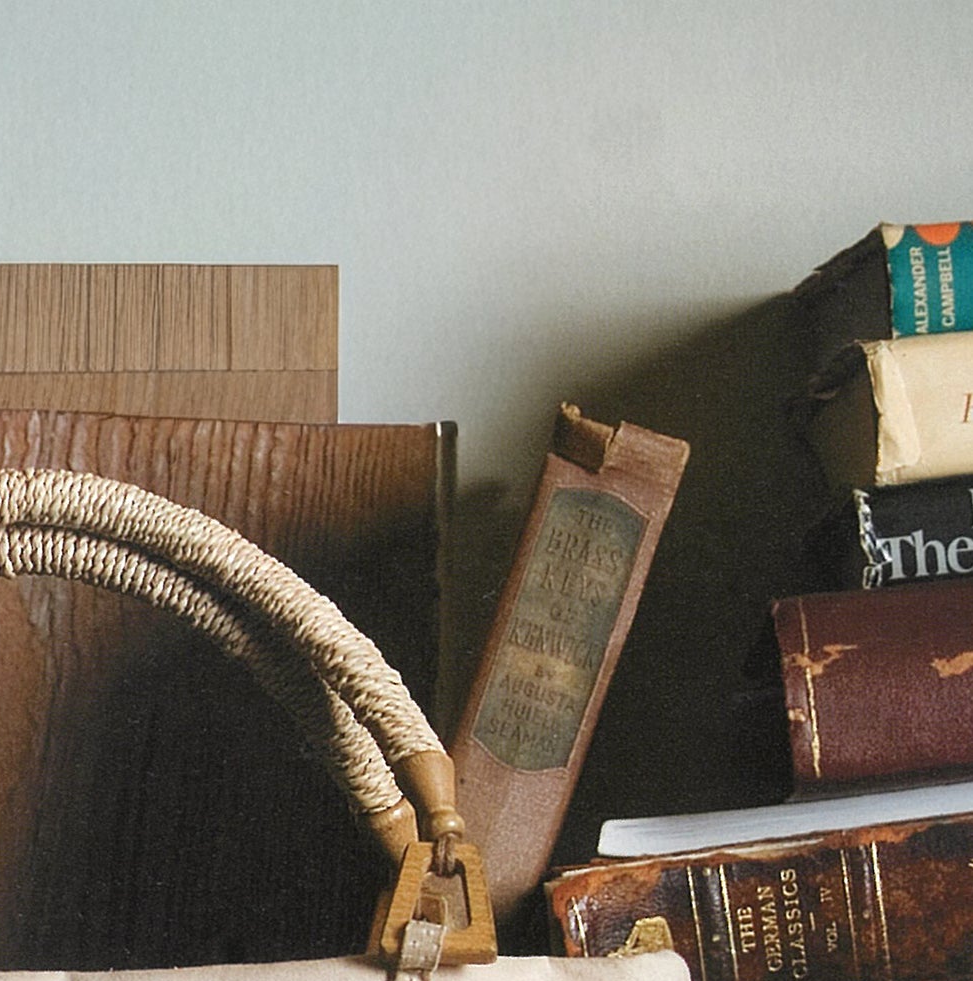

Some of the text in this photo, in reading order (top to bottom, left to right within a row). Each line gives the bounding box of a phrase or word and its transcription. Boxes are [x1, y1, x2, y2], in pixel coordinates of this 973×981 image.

[909, 246, 928, 334] ALEXANDER
[938, 246, 956, 327] CAMPBELL
[578, 509, 614, 532] THE
[546, 528, 624, 577] BRASS
[541, 563, 604, 607] KEYS
[499, 674, 575, 714] AUGUSTA
[820, 886, 833, 903] IV
[737, 906, 757, 953] THE
[757, 885, 783, 972] GERMAN
[780, 868, 808, 979] CLASSICS
